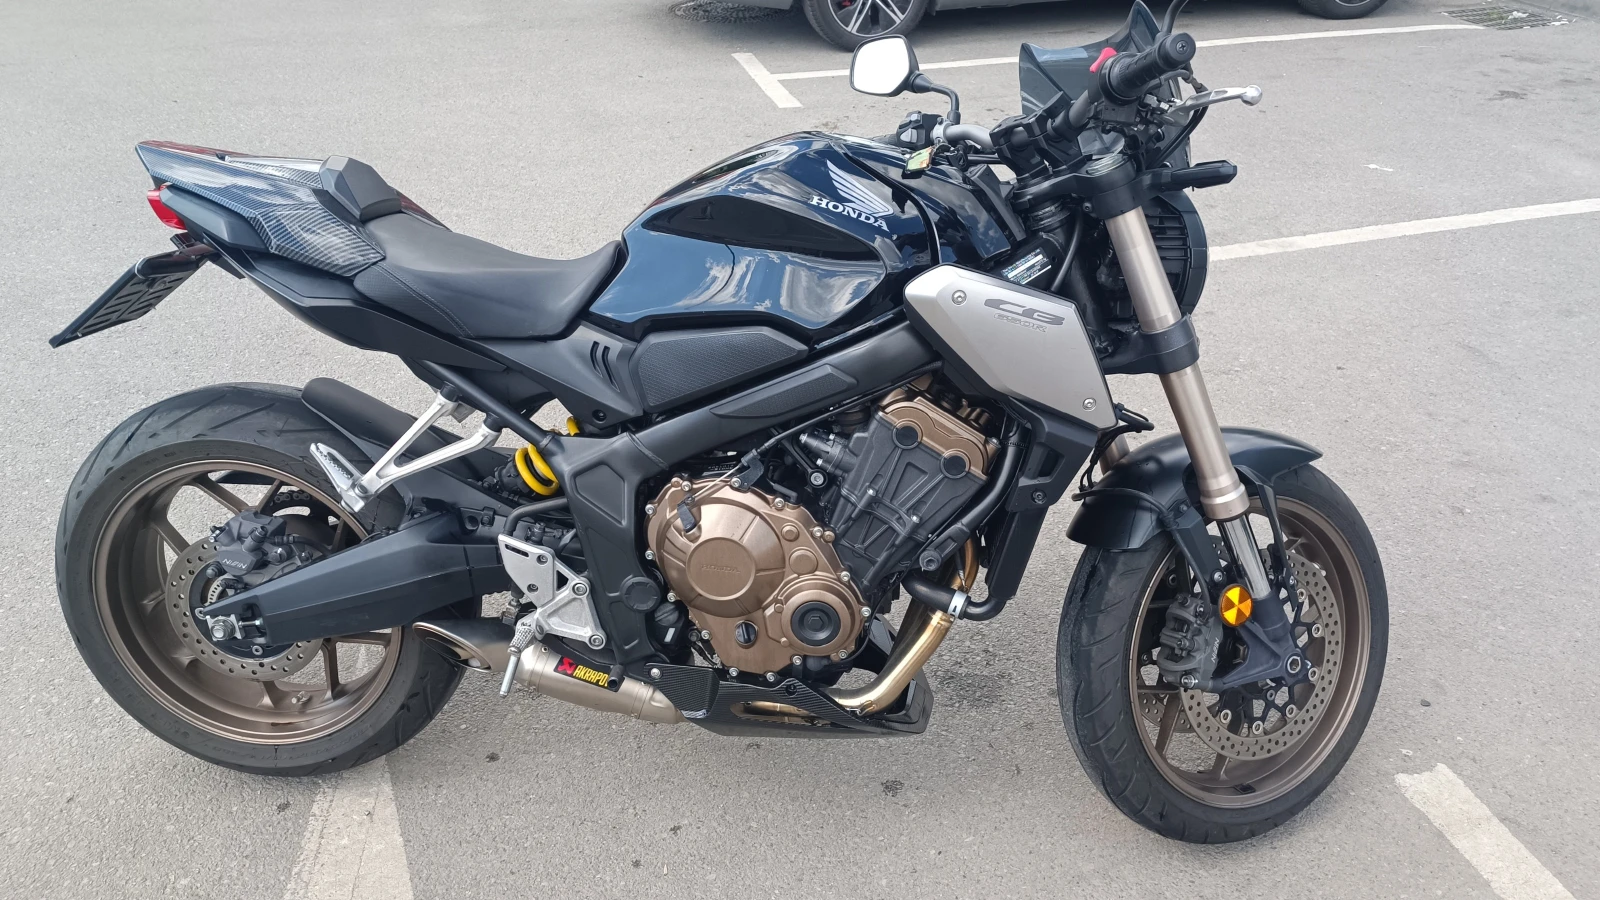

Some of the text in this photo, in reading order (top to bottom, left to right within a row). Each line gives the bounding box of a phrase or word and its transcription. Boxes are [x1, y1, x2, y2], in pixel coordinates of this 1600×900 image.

[809, 195, 890, 233] HONDA
[984, 298, 1065, 326] CB
[572, 664, 609, 687] AKRAPO
